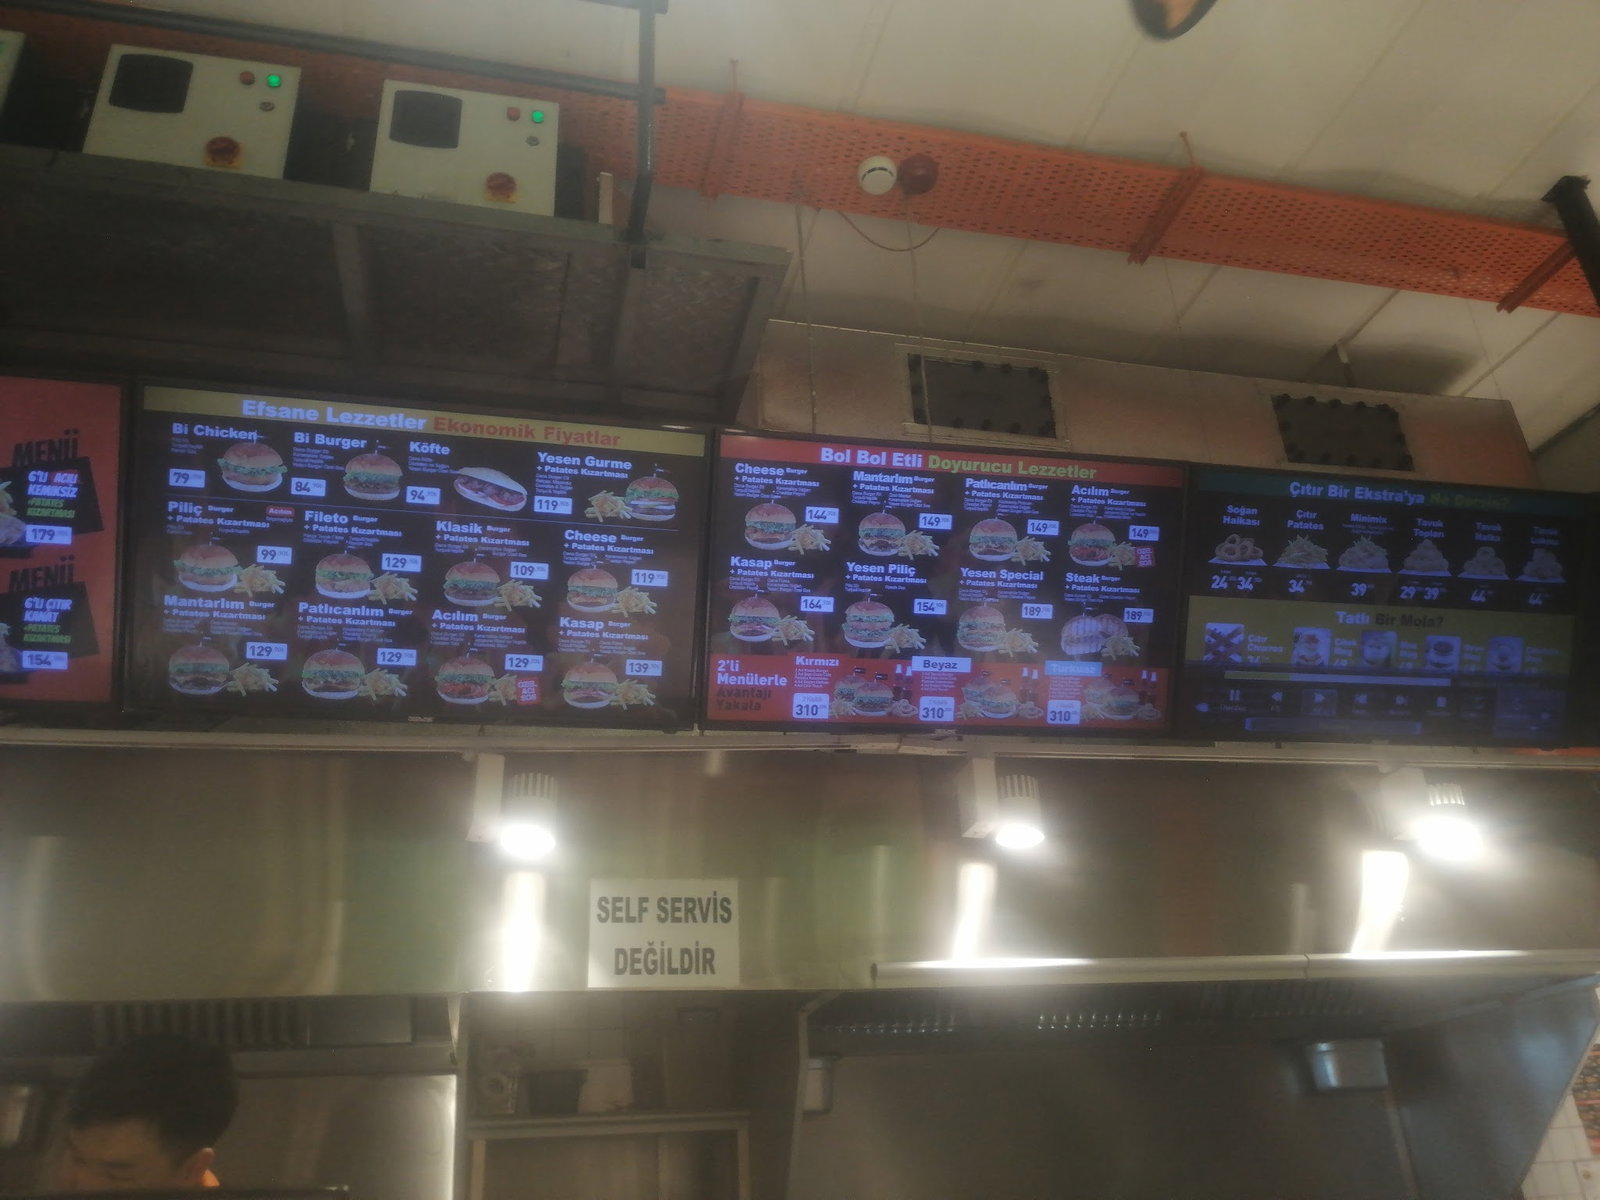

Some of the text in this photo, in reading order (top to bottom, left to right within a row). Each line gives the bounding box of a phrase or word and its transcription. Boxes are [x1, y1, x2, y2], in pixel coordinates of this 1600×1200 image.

[242, 399, 620, 446] Efsane Lezzetler Ekonomik Fiyatlar
[172, 423, 257, 441] Bi Chicken
[294, 431, 367, 450] Bi Burger
[409, 441, 450, 455] Köfte
[537, 452, 632, 470] Yesen Gurme
[821, 448, 1097, 479] Bol Bol Etli Doyurucu Lezzetler
[544, 465, 628, 478] Patates Kızartması
[735, 463, 808, 475] Cheese Burger
[173, 472, 189, 484] 79
[742, 476, 819, 487] Patates Kızartması
[853, 471, 913, 484] Mantarlım
[295, 481, 311, 492] 84
[860, 484, 934, 494] Patates Kızartması
[965, 478, 1027, 491] Patlıcanlım
[1072, 485, 1109, 496] Acılım
[972, 490, 1043, 500] Patates Kızartması
[1289, 481, 1323, 497] Çıtır
[1327, 485, 1350, 498] Bir
[1354, 487, 1425, 506] Ekstra'ya
[168, 501, 234, 515] Piliç Burger
[537, 500, 558, 510] 119
[1227, 505, 1258, 516] Soğan
[304, 511, 349, 524] Fileto
[353, 515, 378, 523] Burger
[808, 509, 827, 520] 144
[1296, 510, 1317, 519] Çıtır
[176, 515, 214, 525] Patates
[217, 518, 269, 528] Kızartması
[922, 516, 940, 526] 149
[1223, 516, 1260, 526] Halkası
[1287, 520, 1324, 530] Patates
[312, 524, 402, 536] Patates Kızartması
[436, 521, 511, 534] Klasik Burger
[1030, 522, 1048, 533] 149
[1132, 528, 1149, 538] 149
[32, 528, 55, 541] 179
[444, 534, 529, 546] Patates Kızartması
[565, 529, 617, 543] Cheese
[571, 542, 654, 554] Patates Kızartması
[261, 549, 276, 560] 99
[385, 557, 406, 568] 129
[730, 556, 772, 570] Kasap
[513, 565, 534, 576] 109
[737, 569, 814, 579] Patates Kızartması
[847, 562, 916, 576] Yesen Piliç
[960, 567, 1043, 582] Yesen Special
[634, 573, 655, 583] 119
[853, 574, 926, 584] Patates Kızartması
[1065, 572, 1100, 584] Steak
[1211, 576, 1253, 590] 24 34
[1072, 584, 1099, 592] Patates
[1288, 580, 1305, 593] 34
[1351, 583, 1367, 596] 39
[1400, 586, 1440, 600] 29 39
[164, 594, 245, 609] Mantarlım
[803, 599, 822, 609] 164
[917, 602, 935, 611] 154
[172, 608, 209, 618] Patates
[299, 601, 384, 616] Patlıcanlım
[1023, 606, 1041, 616] 189
[306, 615, 395, 627] Patates Kızartması
[432, 609, 507, 622] Acılım Burger
[1126, 611, 1142, 621] 189
[1335, 611, 1370, 624] Tatlı
[1376, 613, 1396, 625] Bir
[440, 622, 525, 634] Patates Kızartması
[560, 616, 632, 631] Kasap Burger
[566, 630, 648, 640] Patates Kızartması
[249, 645, 272, 657] 129
[381, 651, 402, 663] 129
[27, 654, 51, 666] 154
[508, 657, 529, 668] 129
[717, 660, 739, 672] 2'li
[795, 656, 839, 667] Kırmızı
[923, 660, 957, 671] Beyaz
[628, 662, 648, 673] 139
[717, 673, 787, 686] Menülerle
[795, 704, 818, 716] 310
[922, 707, 944, 718] 310
[1050, 710, 1070, 721] 310
[597, 890, 732, 924] SELF SERVİS
[614, 941, 716, 975] DEĞİLDİR
